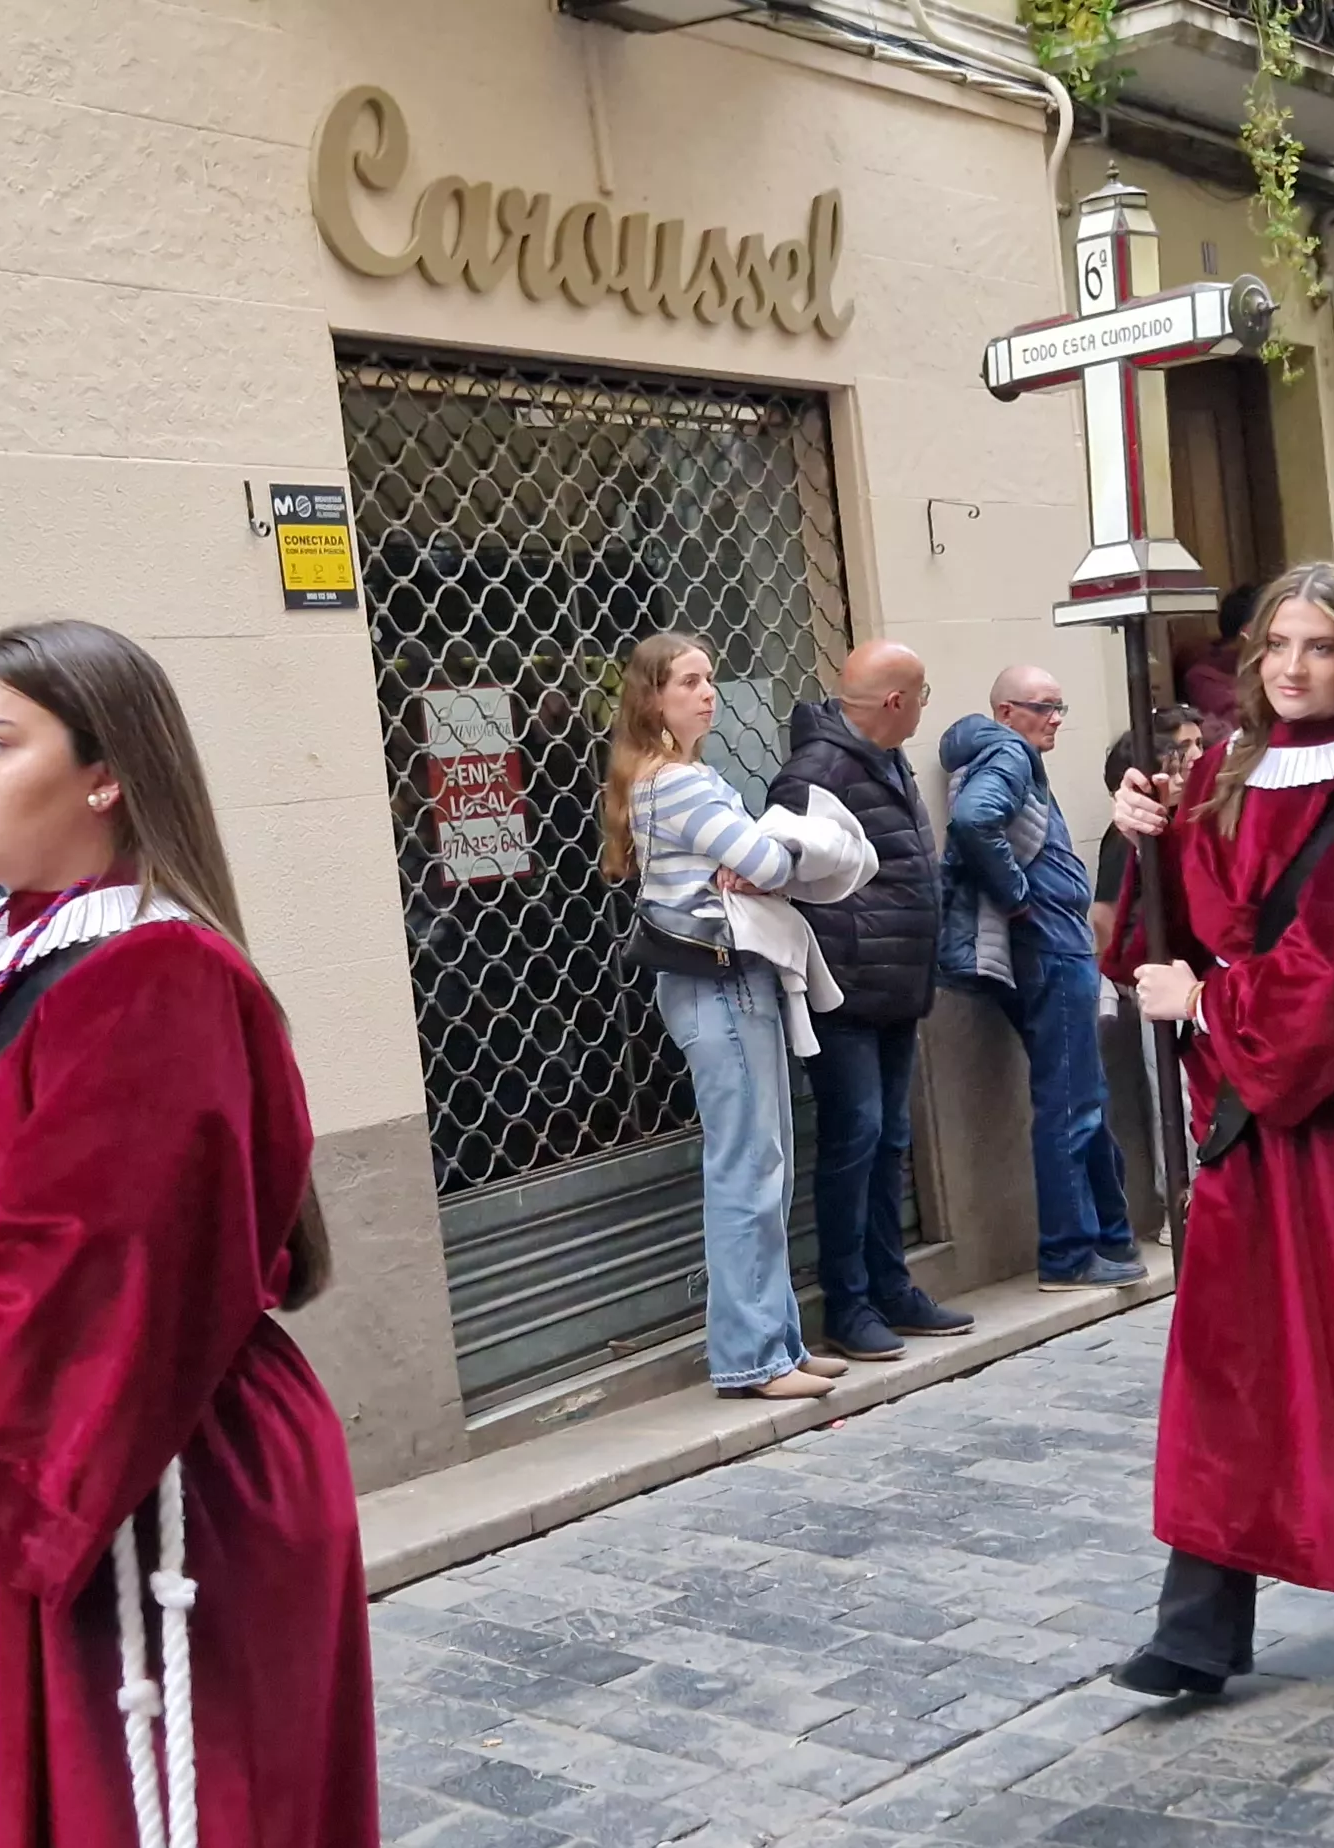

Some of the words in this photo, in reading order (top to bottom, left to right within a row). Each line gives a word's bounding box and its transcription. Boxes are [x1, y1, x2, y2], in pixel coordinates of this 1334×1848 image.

[309, 83, 856, 340] Caroussel
[1022, 343, 1058, 365] TODO
[1063, 333, 1096, 356] ESTA
[1101, 316, 1173, 345] CUMPLIDO
[284, 535, 345, 546] CONECTADA
[446, 761, 507, 787] ENE
[450, 791, 509, 818] LOCAL
